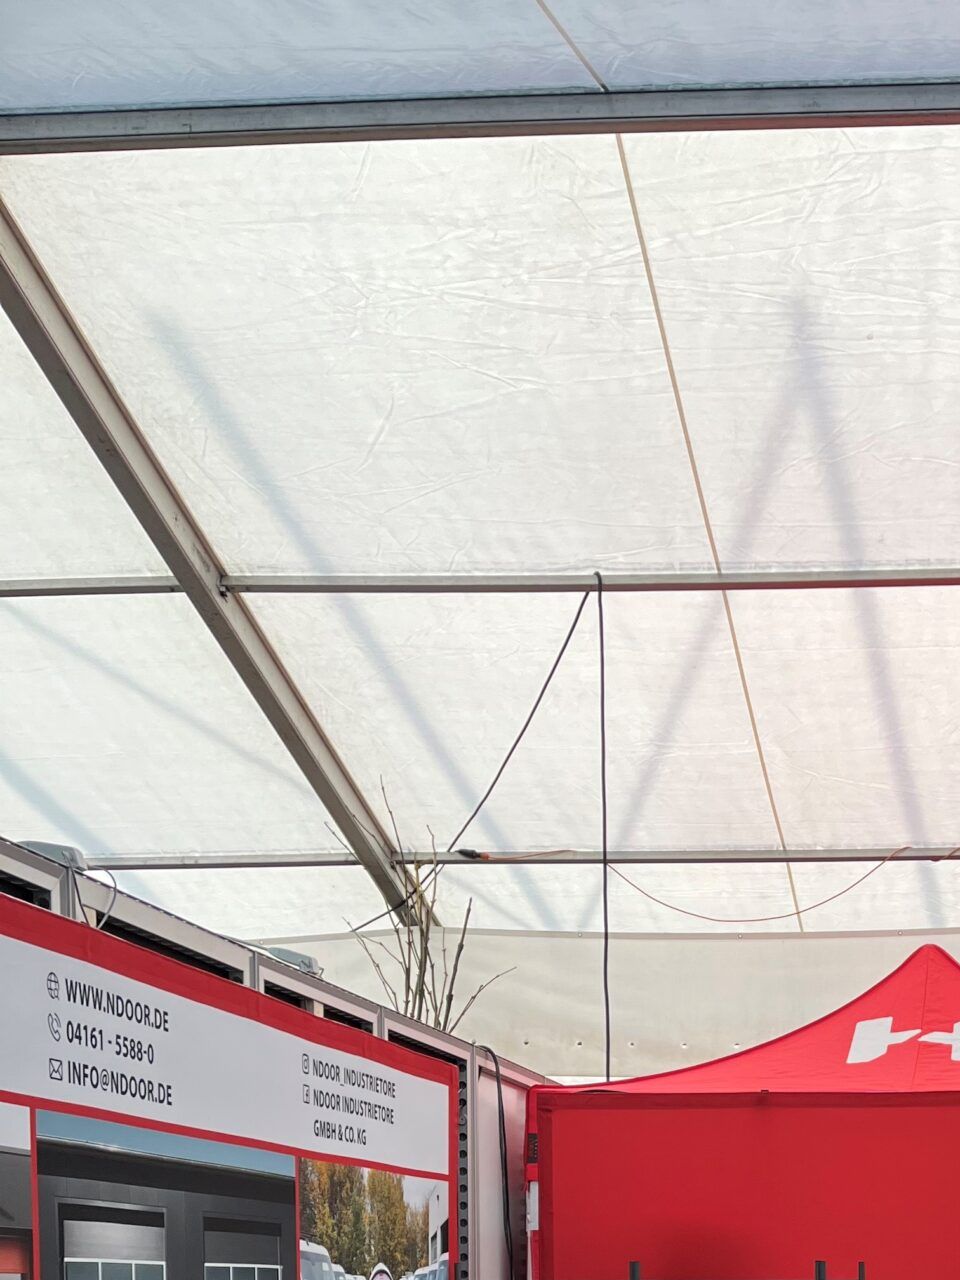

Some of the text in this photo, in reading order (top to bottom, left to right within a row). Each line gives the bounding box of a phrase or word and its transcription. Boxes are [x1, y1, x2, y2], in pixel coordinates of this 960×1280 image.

[65, 978, 169, 1032] WWW.NDOOR.DE
[66, 1020, 103, 1051] 04161
[115, 1034, 154, 1064] 5588-0
[68, 1060, 173, 1106] INFO@NDOOR.DE
[312, 1058, 396, 1098] NDOOR_INDUSTRIETORE
[313, 1088, 394, 1125] NDOOR INDUSTRIETORE
[313, 1119, 336, 1140] GMBH
[338, 1124, 343, 1141] &
[356, 1127, 367, 1146] KG
